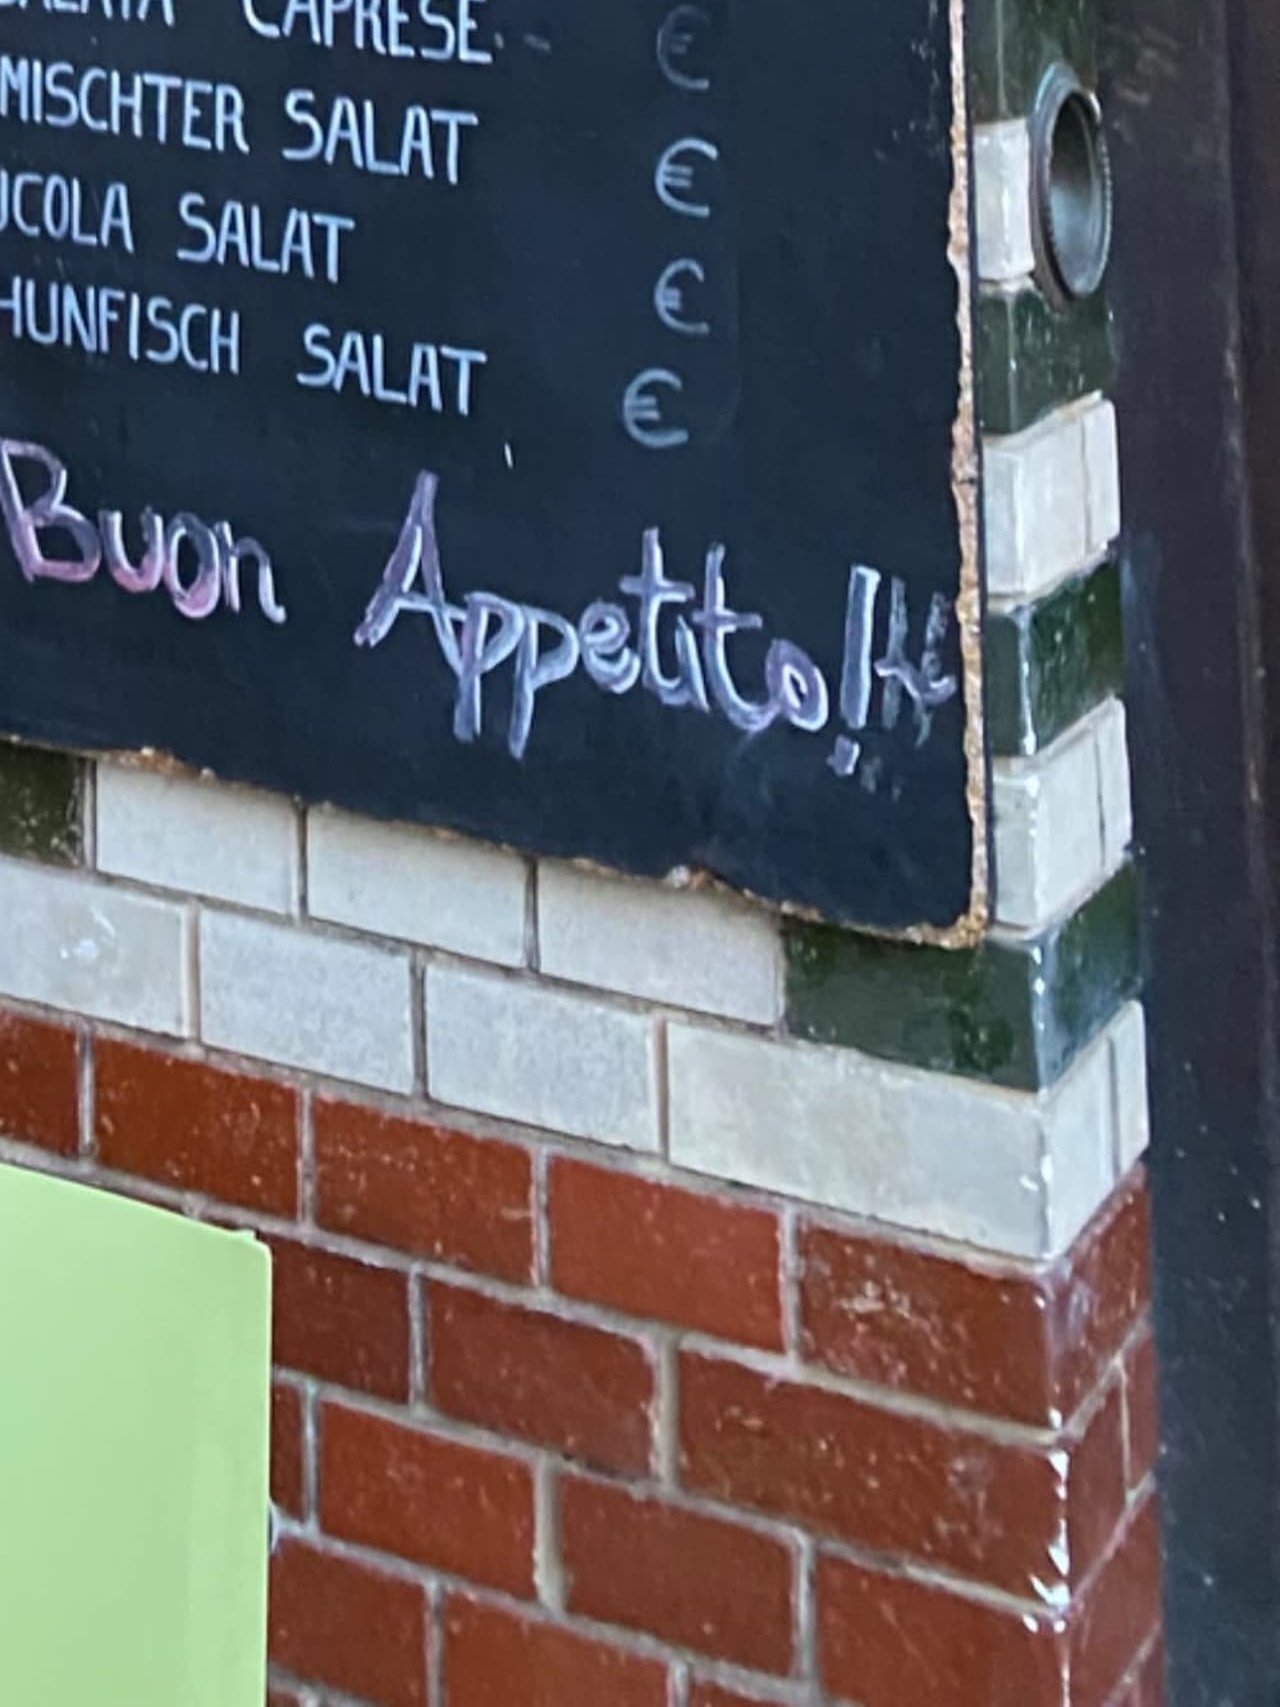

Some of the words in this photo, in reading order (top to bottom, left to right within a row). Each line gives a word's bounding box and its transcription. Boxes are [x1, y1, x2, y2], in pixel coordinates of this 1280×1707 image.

[283, 88, 479, 186] SALAT
[654, 136, 720, 219] €
[176, 192, 355, 284] SALAT
[653, 259, 711, 335] €
[296, 323, 487, 417] SALAT
[623, 368, 690, 449] €
